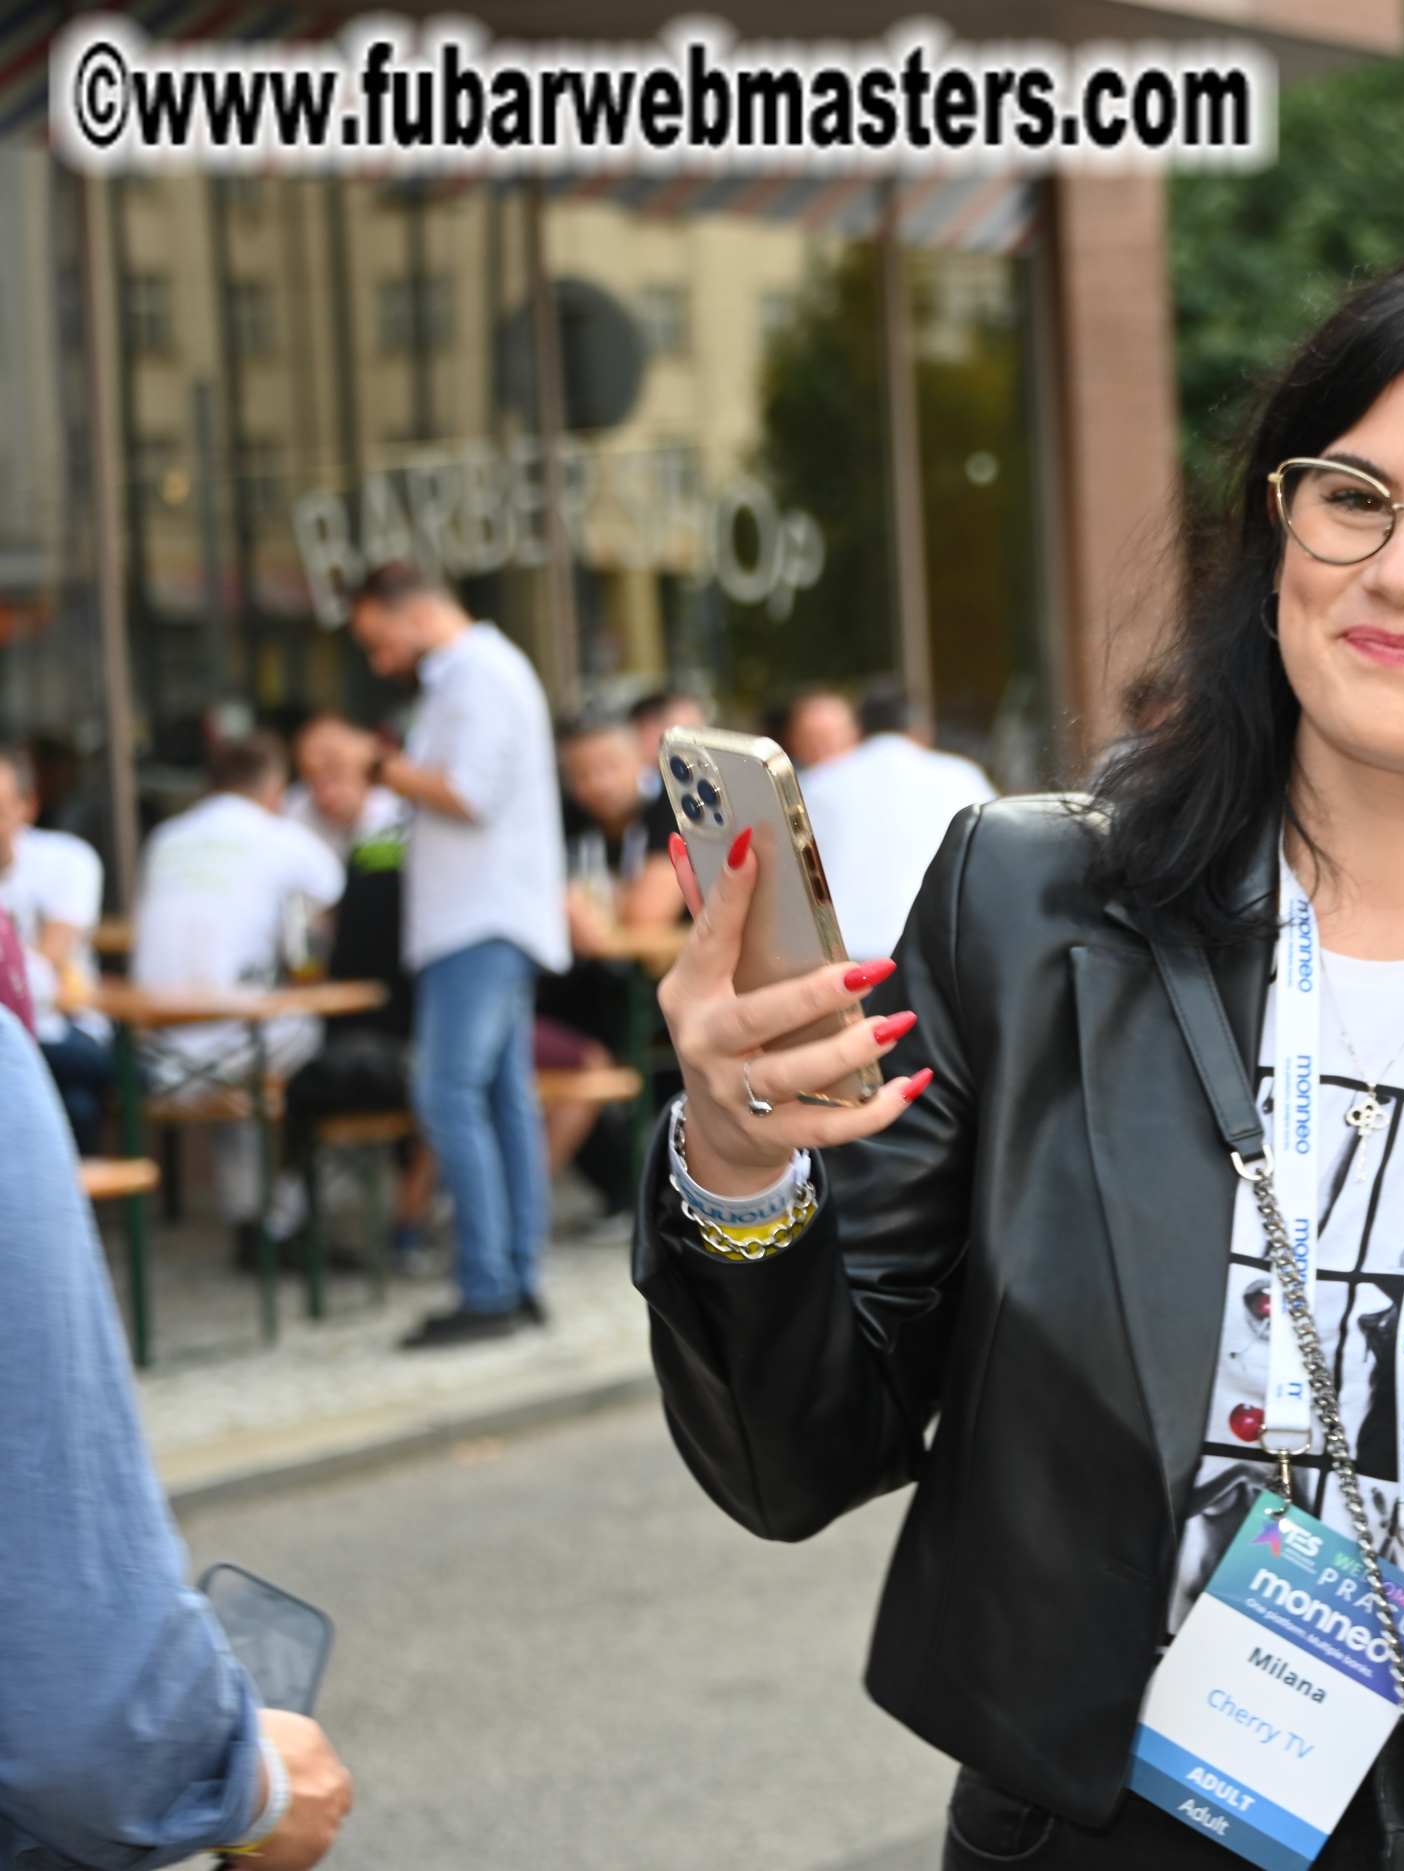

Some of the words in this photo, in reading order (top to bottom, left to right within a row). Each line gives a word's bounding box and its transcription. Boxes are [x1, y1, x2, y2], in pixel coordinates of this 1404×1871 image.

[1298, 898, 1313, 992] monneo
[1297, 1055, 1311, 1154] monneo
[1249, 1568, 1390, 1663] monneo
[1248, 1647, 1327, 1704] Milana
[1207, 1689, 1281, 1744] Cherry
[1284, 1732, 1316, 1759] TV
[1178, 1798, 1230, 1836] Adult
[1185, 1767, 1256, 1811] ADULT
